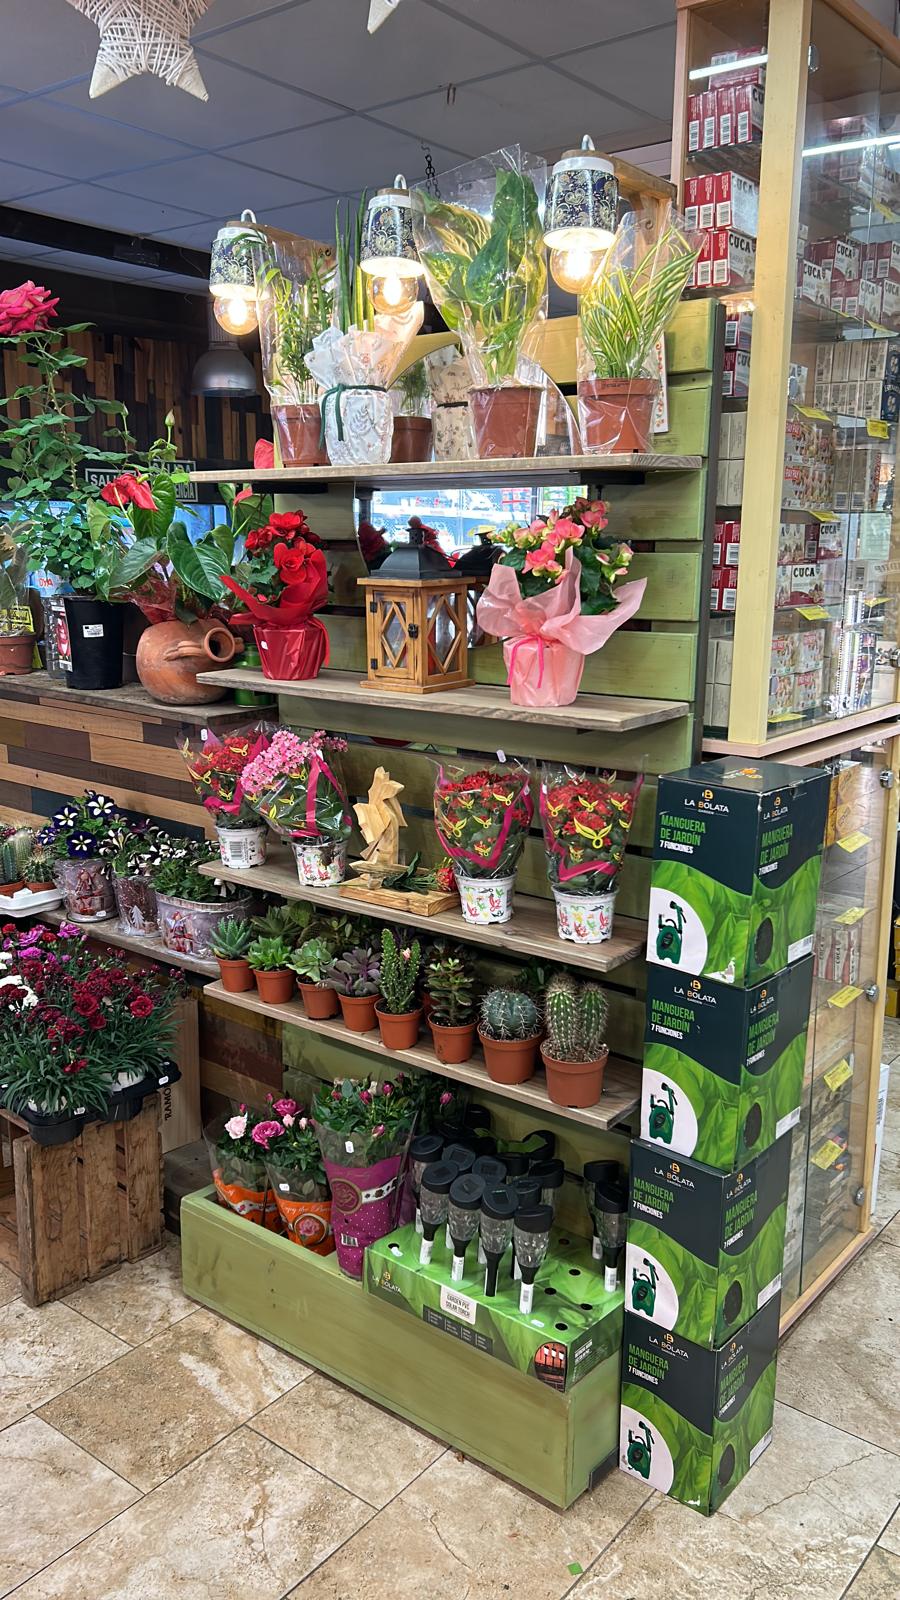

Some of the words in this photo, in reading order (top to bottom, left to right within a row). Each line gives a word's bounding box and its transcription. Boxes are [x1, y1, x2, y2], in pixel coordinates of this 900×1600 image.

[729, 233, 751, 253] CUCA
[837, 243, 853, 259] CUCA
[804, 263, 820, 280] CUCA
[821, 526, 837, 535] CUCA
[794, 567, 815, 578] CUCA
[684, 799, 696, 807] LA
[698, 801, 730, 813] BOLATA
[661, 814, 706, 834] MANGUERA
[660, 828, 672, 840] DE
[672, 831, 701, 846] JARDÍN
[660, 840, 664, 848] 7
[664, 841, 694, 854] FUNCIONES
[674, 986, 685, 995] LA
[687, 990, 717, 1004] BOLATA
[652, 999, 695, 1022] MANGUERA
[651, 1012, 662, 1024] DE
[663, 1015, 690, 1033] JARDÍN
[651, 1023, 656, 1031] 7
[655, 1025, 684, 1040] FUNCIONES
[654, 1167, 664, 1176] LA
[667, 1173, 695, 1188] BOLATA
[634, 1177, 674, 1202] MANGUERA
[632, 1200, 637, 1208] 7
[637, 1202, 664, 1219] FUNCIONES
[633, 1190, 643, 1202] DE
[644, 1194, 670, 1213] JARDÍN
[649, 1336, 659, 1344] LA
[661, 1342, 689, 1358] BOLATA
[629, 1344, 669, 1371] MANGUERA
[628, 1356, 639, 1368] DE
[640, 1360, 665, 1380] JARDÍN
[632, 1367, 659, 1385] FUNCIONES
